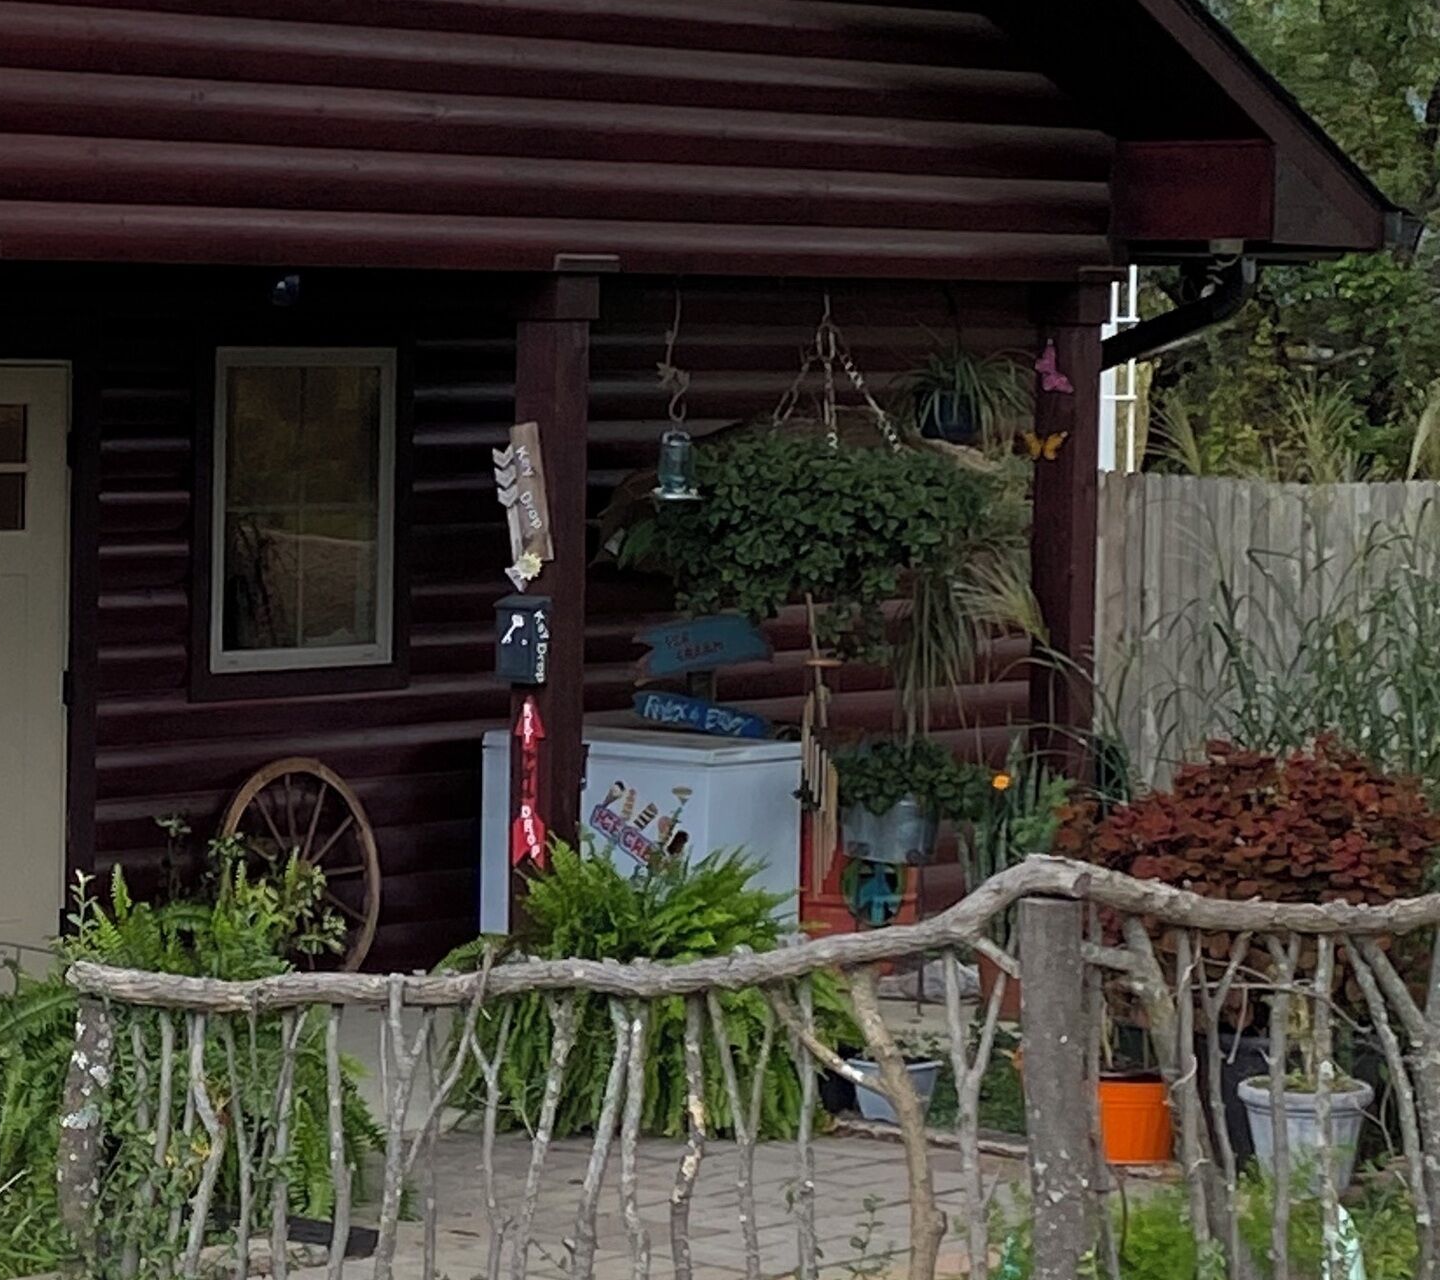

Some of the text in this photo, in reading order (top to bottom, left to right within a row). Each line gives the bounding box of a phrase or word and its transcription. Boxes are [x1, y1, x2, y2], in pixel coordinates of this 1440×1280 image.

[515, 445, 543, 530] Key Drop
[534, 610, 549, 683] Key Drop
[521, 703, 540, 859] KEY DROP
